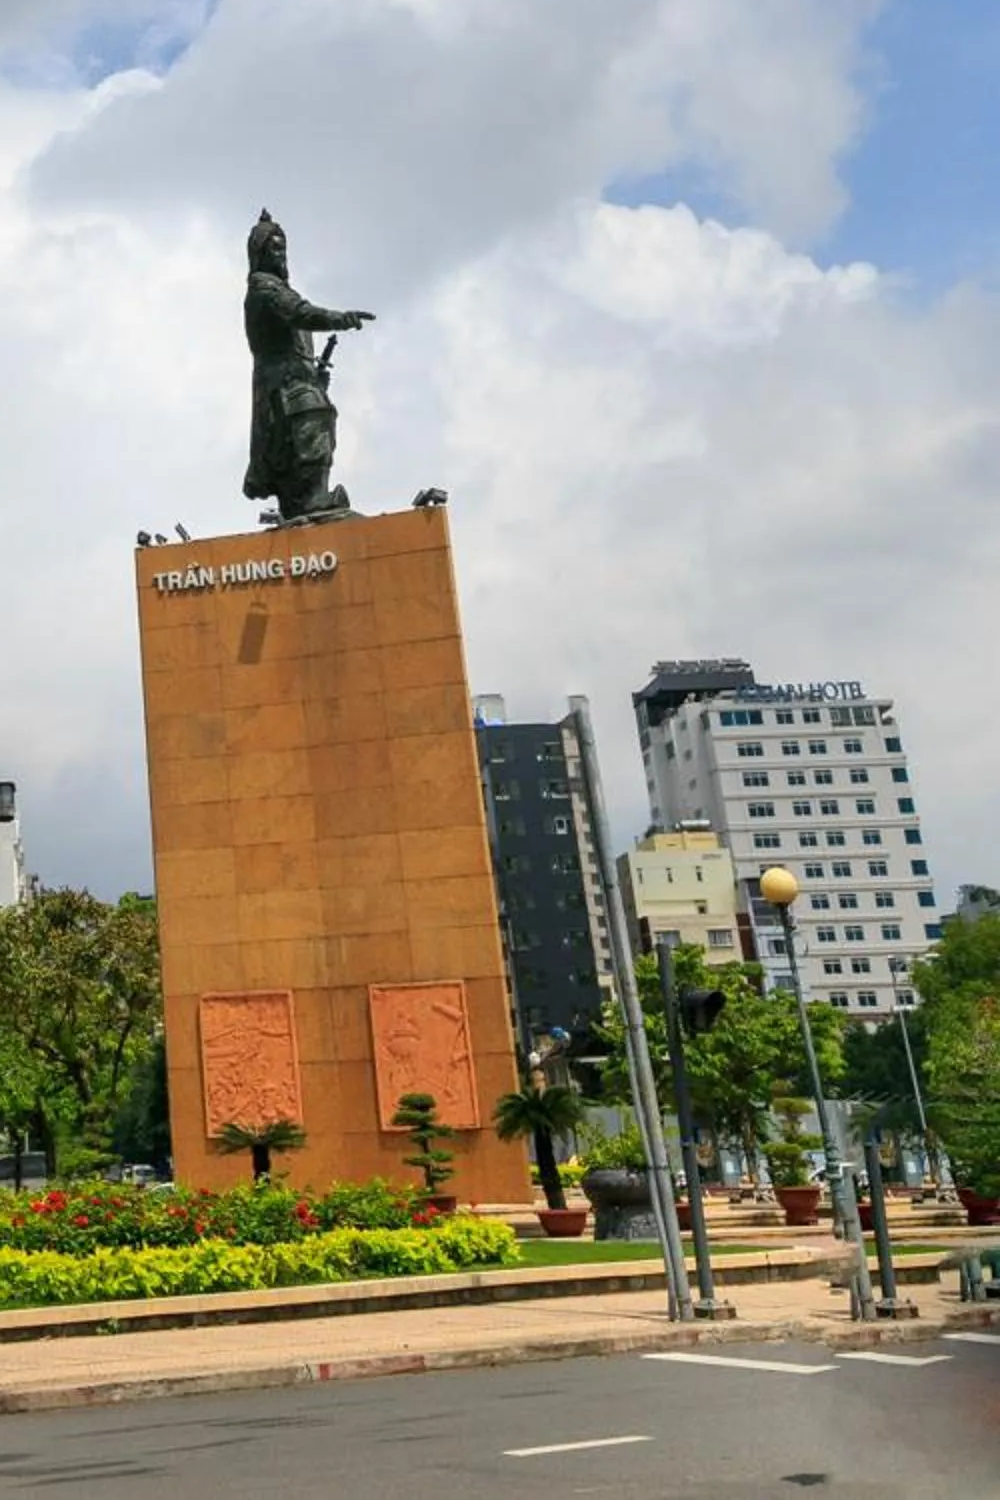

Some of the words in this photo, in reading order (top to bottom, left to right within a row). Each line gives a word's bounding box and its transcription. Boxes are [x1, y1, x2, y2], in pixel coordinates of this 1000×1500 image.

[153, 561, 215, 591] TRẦN
[290, 551, 338, 577] ĐẠO
[809, 680, 866, 701] HOTEL
